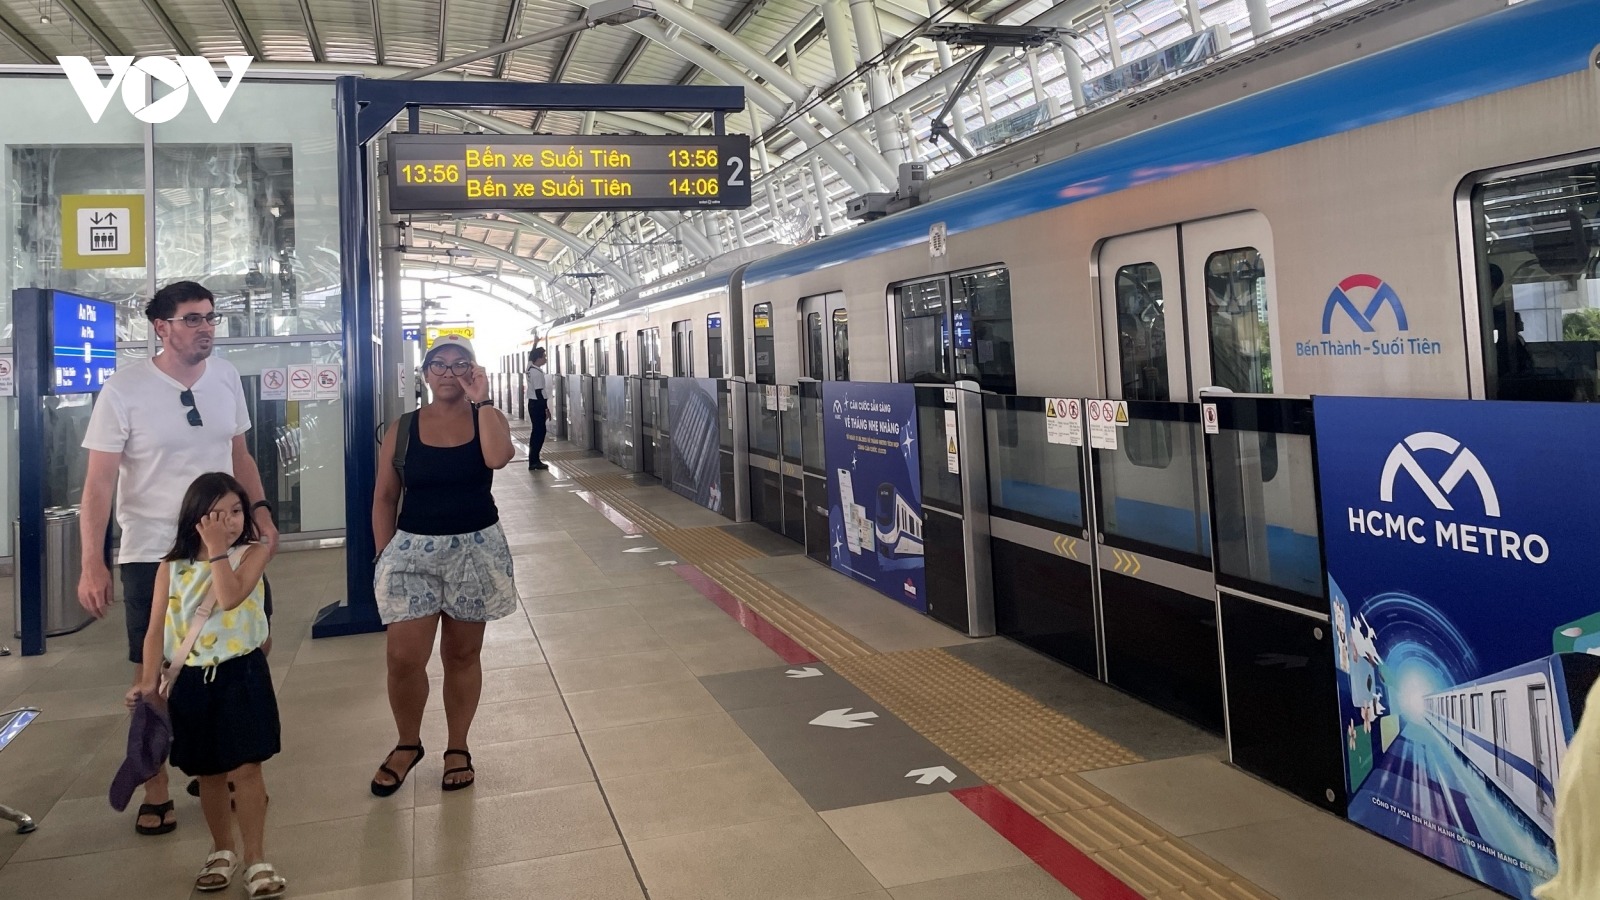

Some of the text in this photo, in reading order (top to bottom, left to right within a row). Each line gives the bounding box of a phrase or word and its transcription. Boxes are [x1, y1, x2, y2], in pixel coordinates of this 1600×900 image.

[466, 145, 718, 168] Bến xe Suối Tiên 13:56
[402, 164, 459, 183] 13:56
[727, 156, 745, 186] 2
[467, 175, 719, 197] Bến xe Suối Tiên 14:06
[1296, 340, 1319, 356] Bến
[1320, 340, 1361, 356] Thành
[1372, 337, 1405, 355] Suối
[1407, 337, 1441, 354] Tiên
[851, 416, 868, 430] THÁNG
[868, 420, 879, 435] NHẸ
[879, 419, 900, 435] NHÀNG
[1348, 507, 1550, 564] HCMC METRO
[1372, 796, 1390, 810] CÔNG
[1390, 804, 1397, 813] TY
[1397, 808, 1411, 819] HOA
[1411, 814, 1423, 824] SEN
[1497, 851, 1518, 866] MANG
